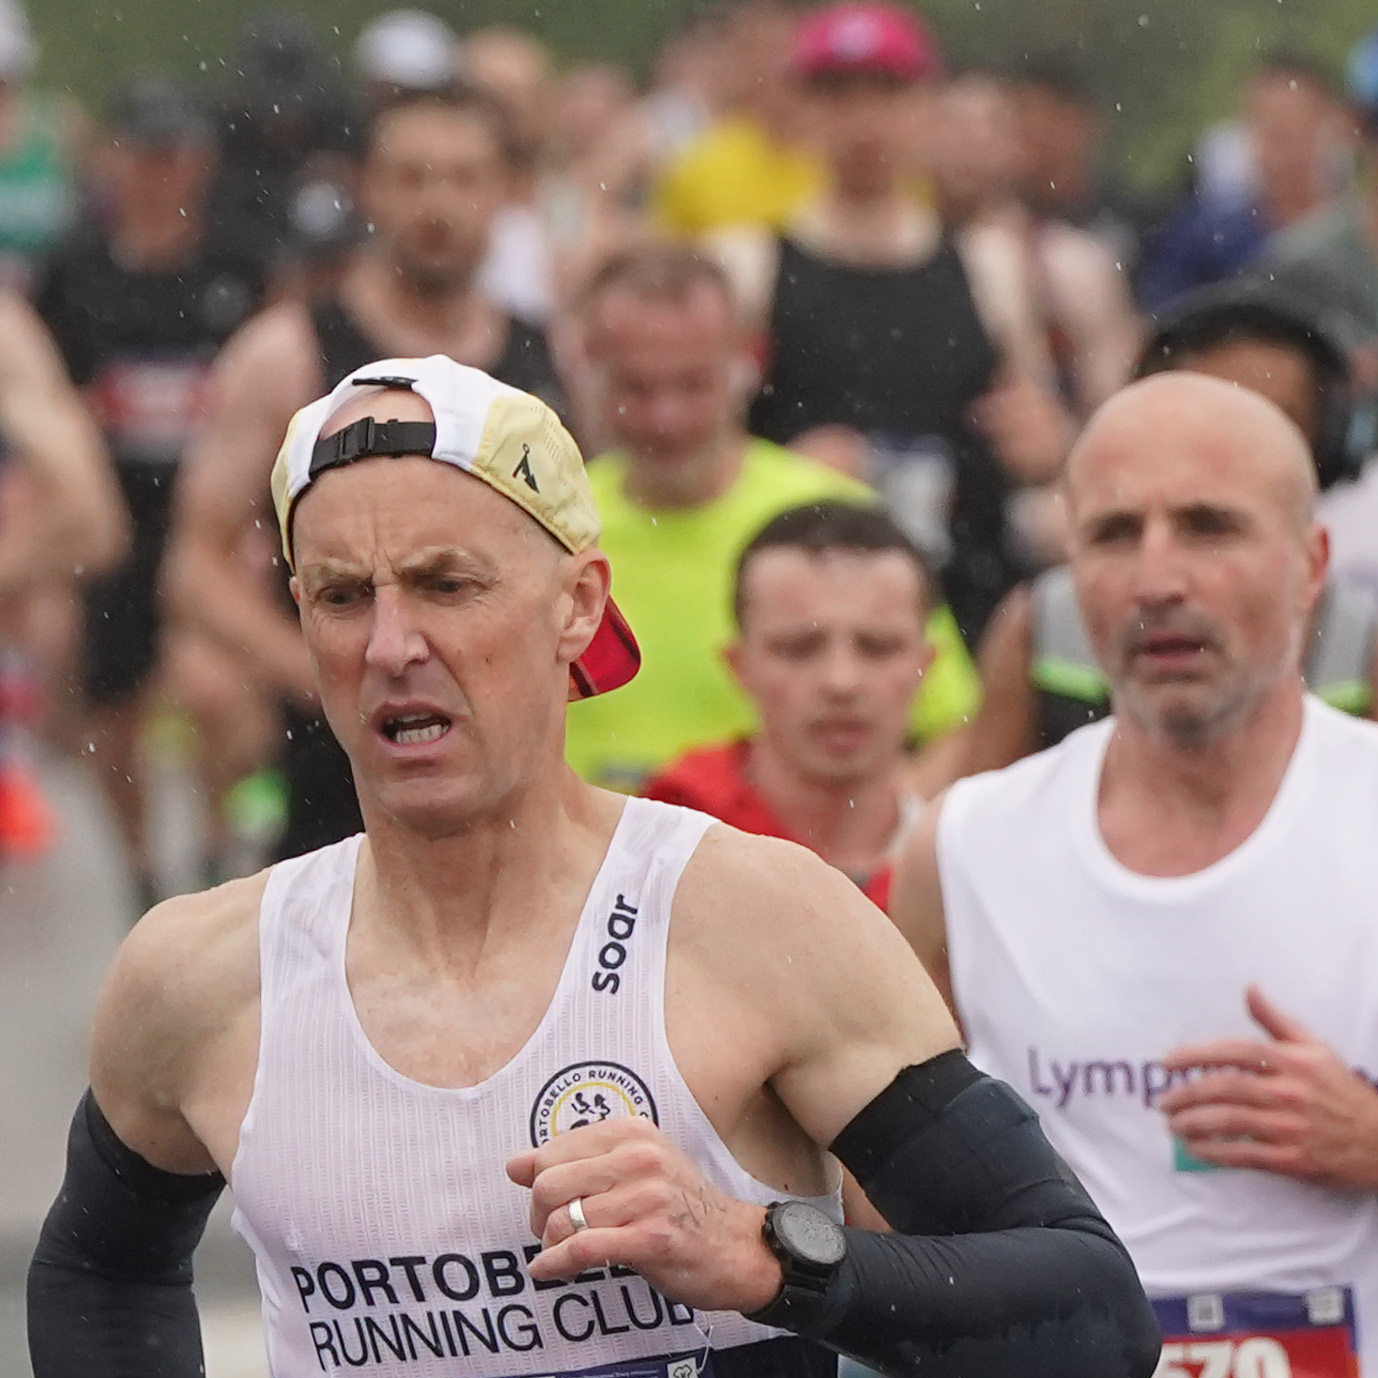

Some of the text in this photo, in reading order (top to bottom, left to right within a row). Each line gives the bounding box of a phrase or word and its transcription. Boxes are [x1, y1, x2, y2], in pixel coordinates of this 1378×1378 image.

[592, 893, 638, 995] soar
[538, 1070, 643, 1145] RTOBELLO RUNNING
[308, 1303, 544, 1372] RUNNING
